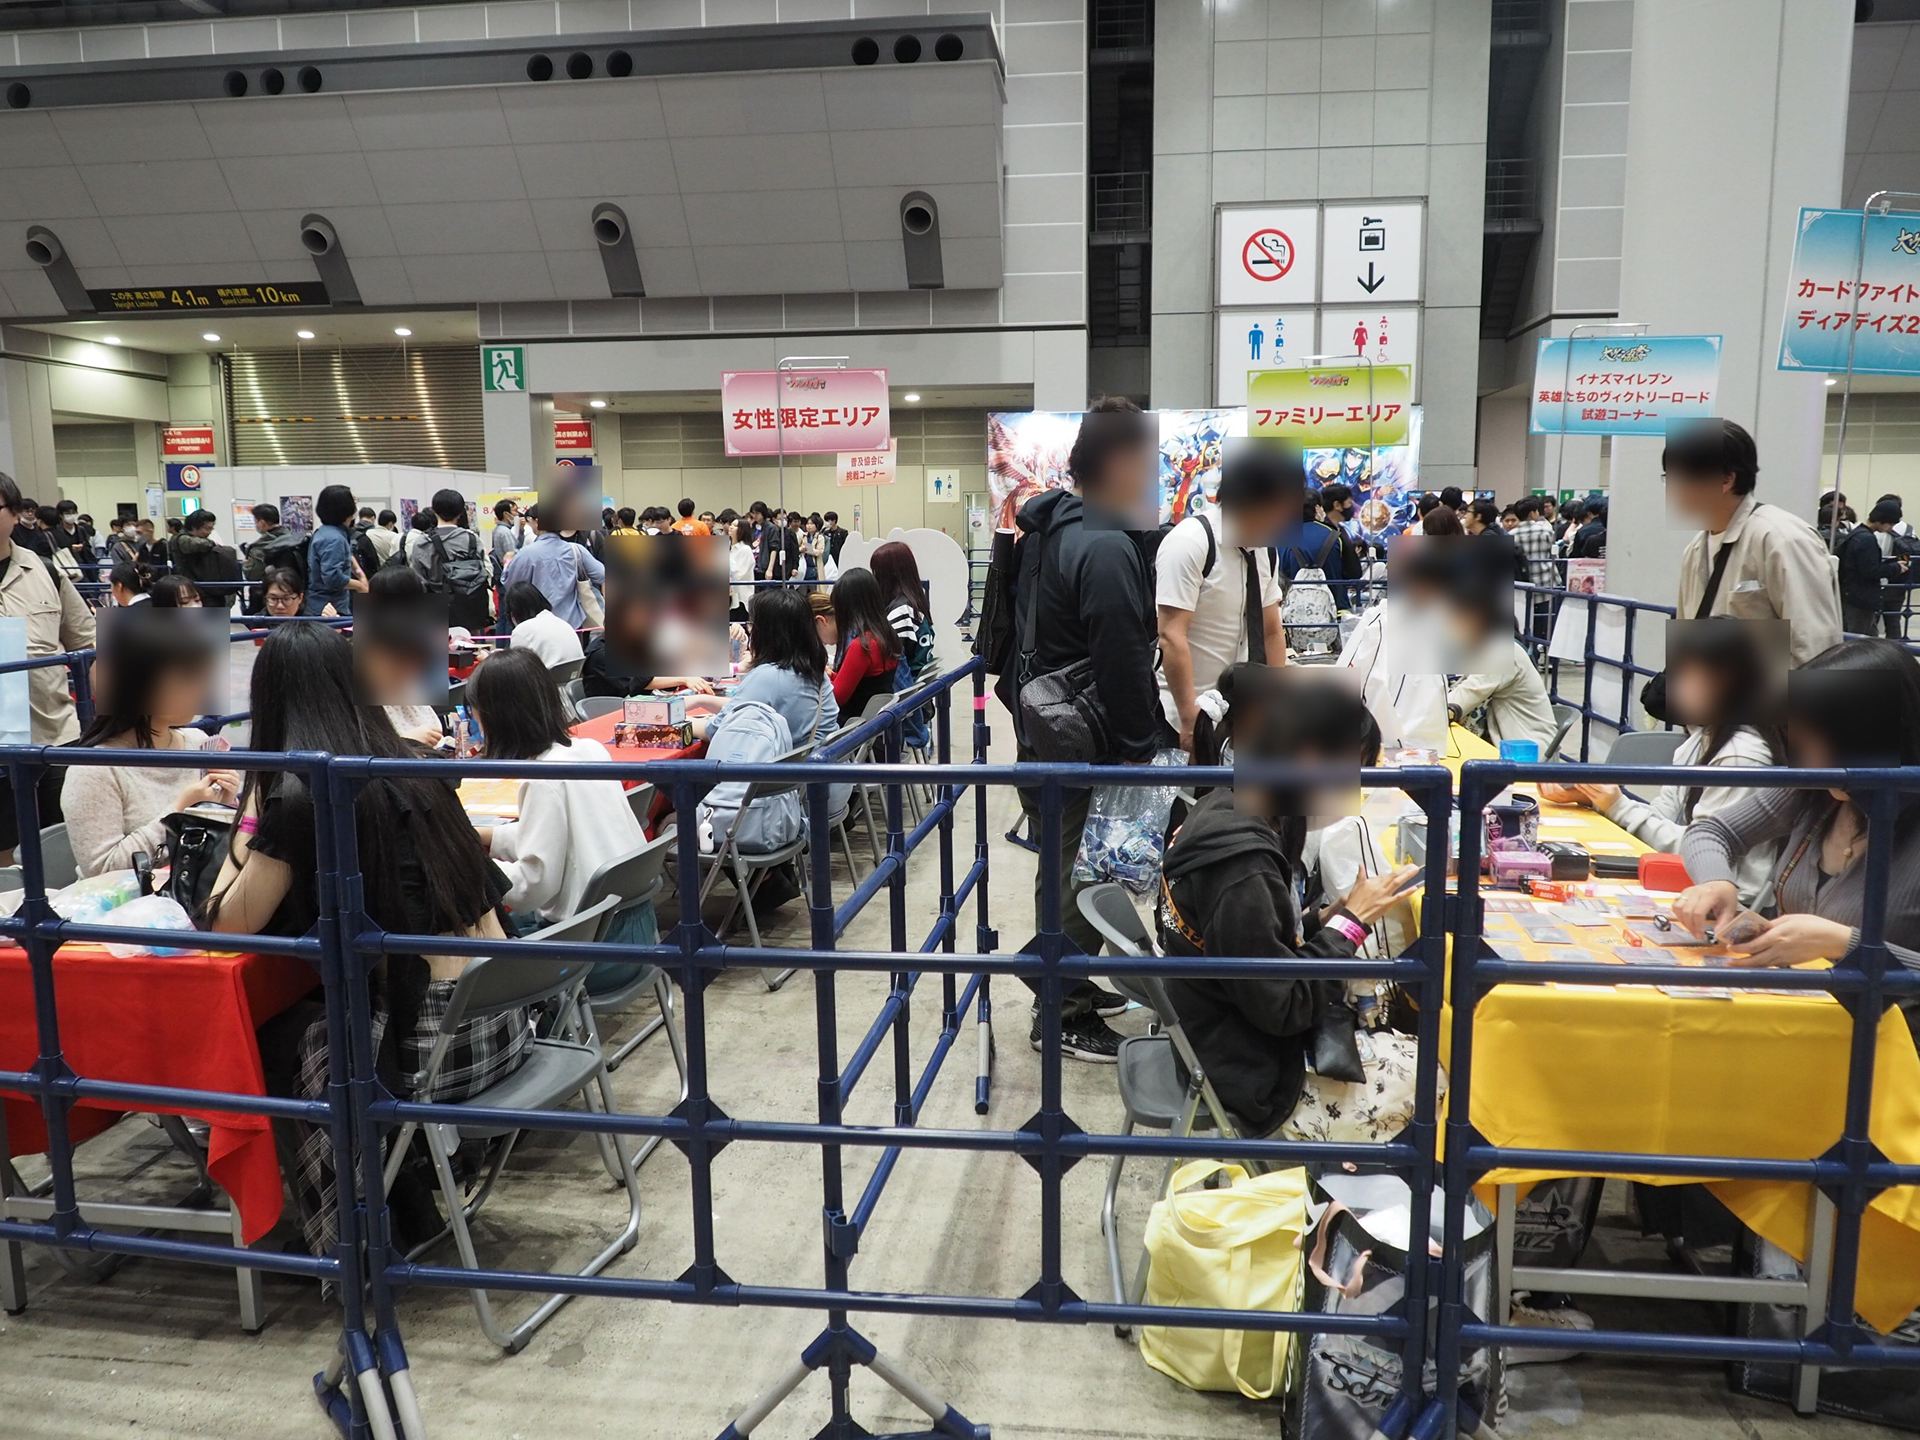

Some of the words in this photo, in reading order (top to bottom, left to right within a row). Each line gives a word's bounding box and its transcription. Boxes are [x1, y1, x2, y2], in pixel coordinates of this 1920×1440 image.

[1576, 373, 1673, 385] イナズマイレブン
[732, 406, 881, 430] 女性限定エリア
[1255, 404, 1401, 426] ファミリーエリア
[1581, 408, 1658, 421] 試遊コーナー
[851, 455, 884, 467] 普及協会に
[846, 470, 886, 481] 挑戦コーナー
